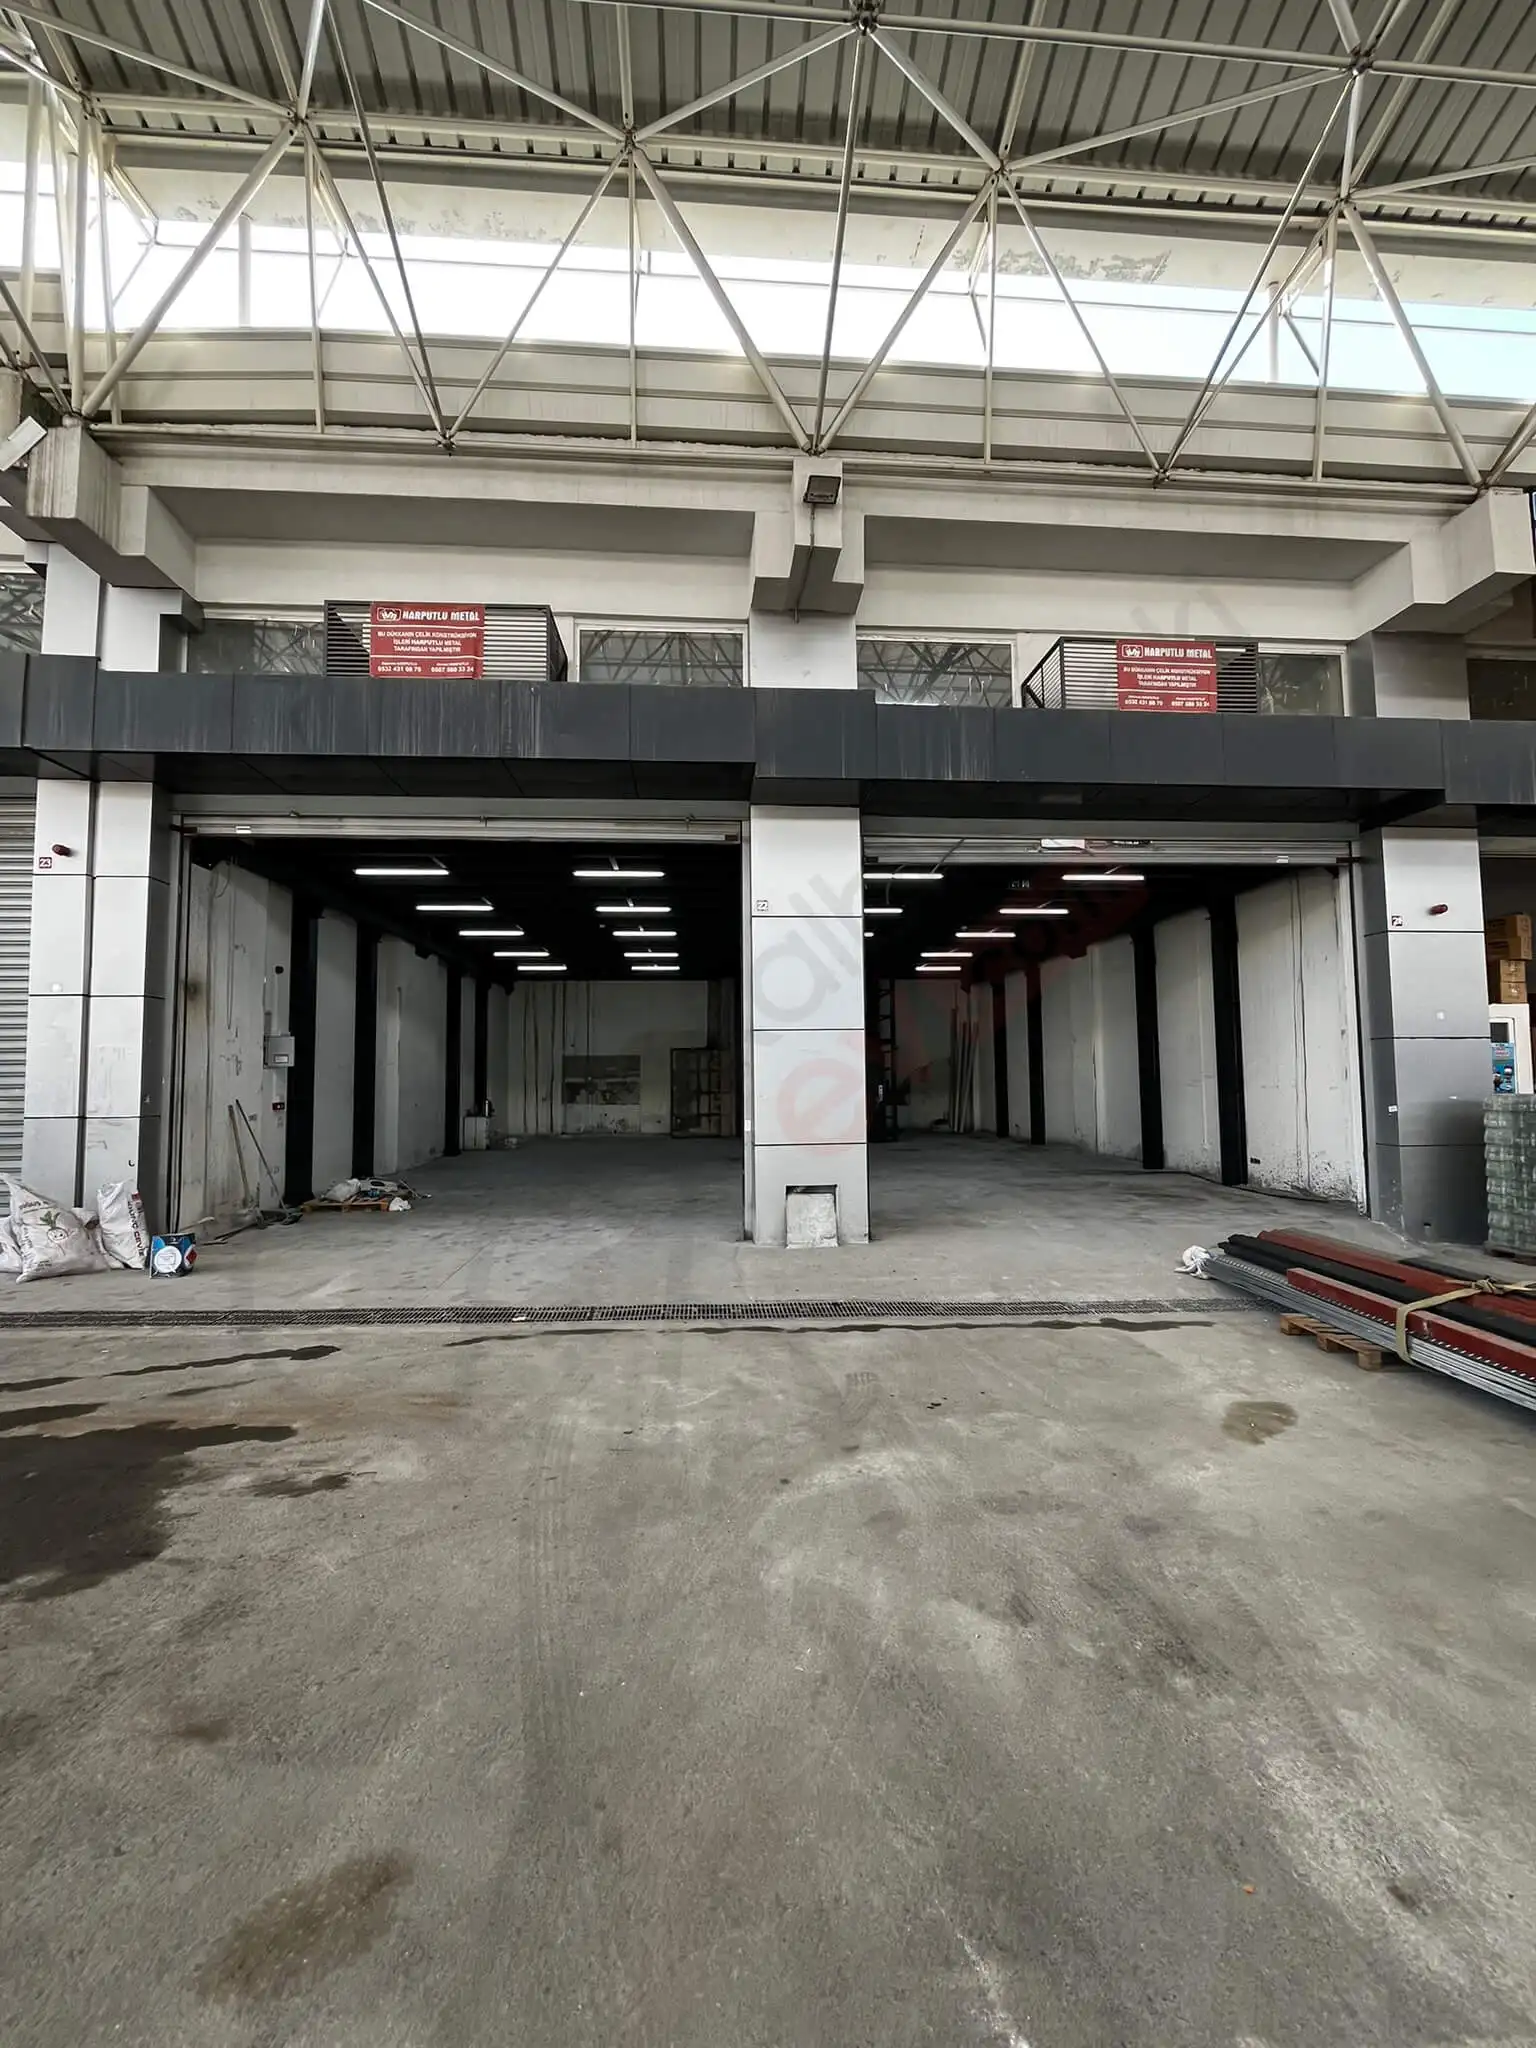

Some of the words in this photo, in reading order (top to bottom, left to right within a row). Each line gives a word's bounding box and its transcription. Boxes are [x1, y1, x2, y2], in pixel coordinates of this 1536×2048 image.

[402, 610, 448, 621] HARPUTLU
[450, 611, 480, 621] METAL
[1144, 647, 1185, 658] HARPUTLU
[1186, 648, 1213, 659] METAL
